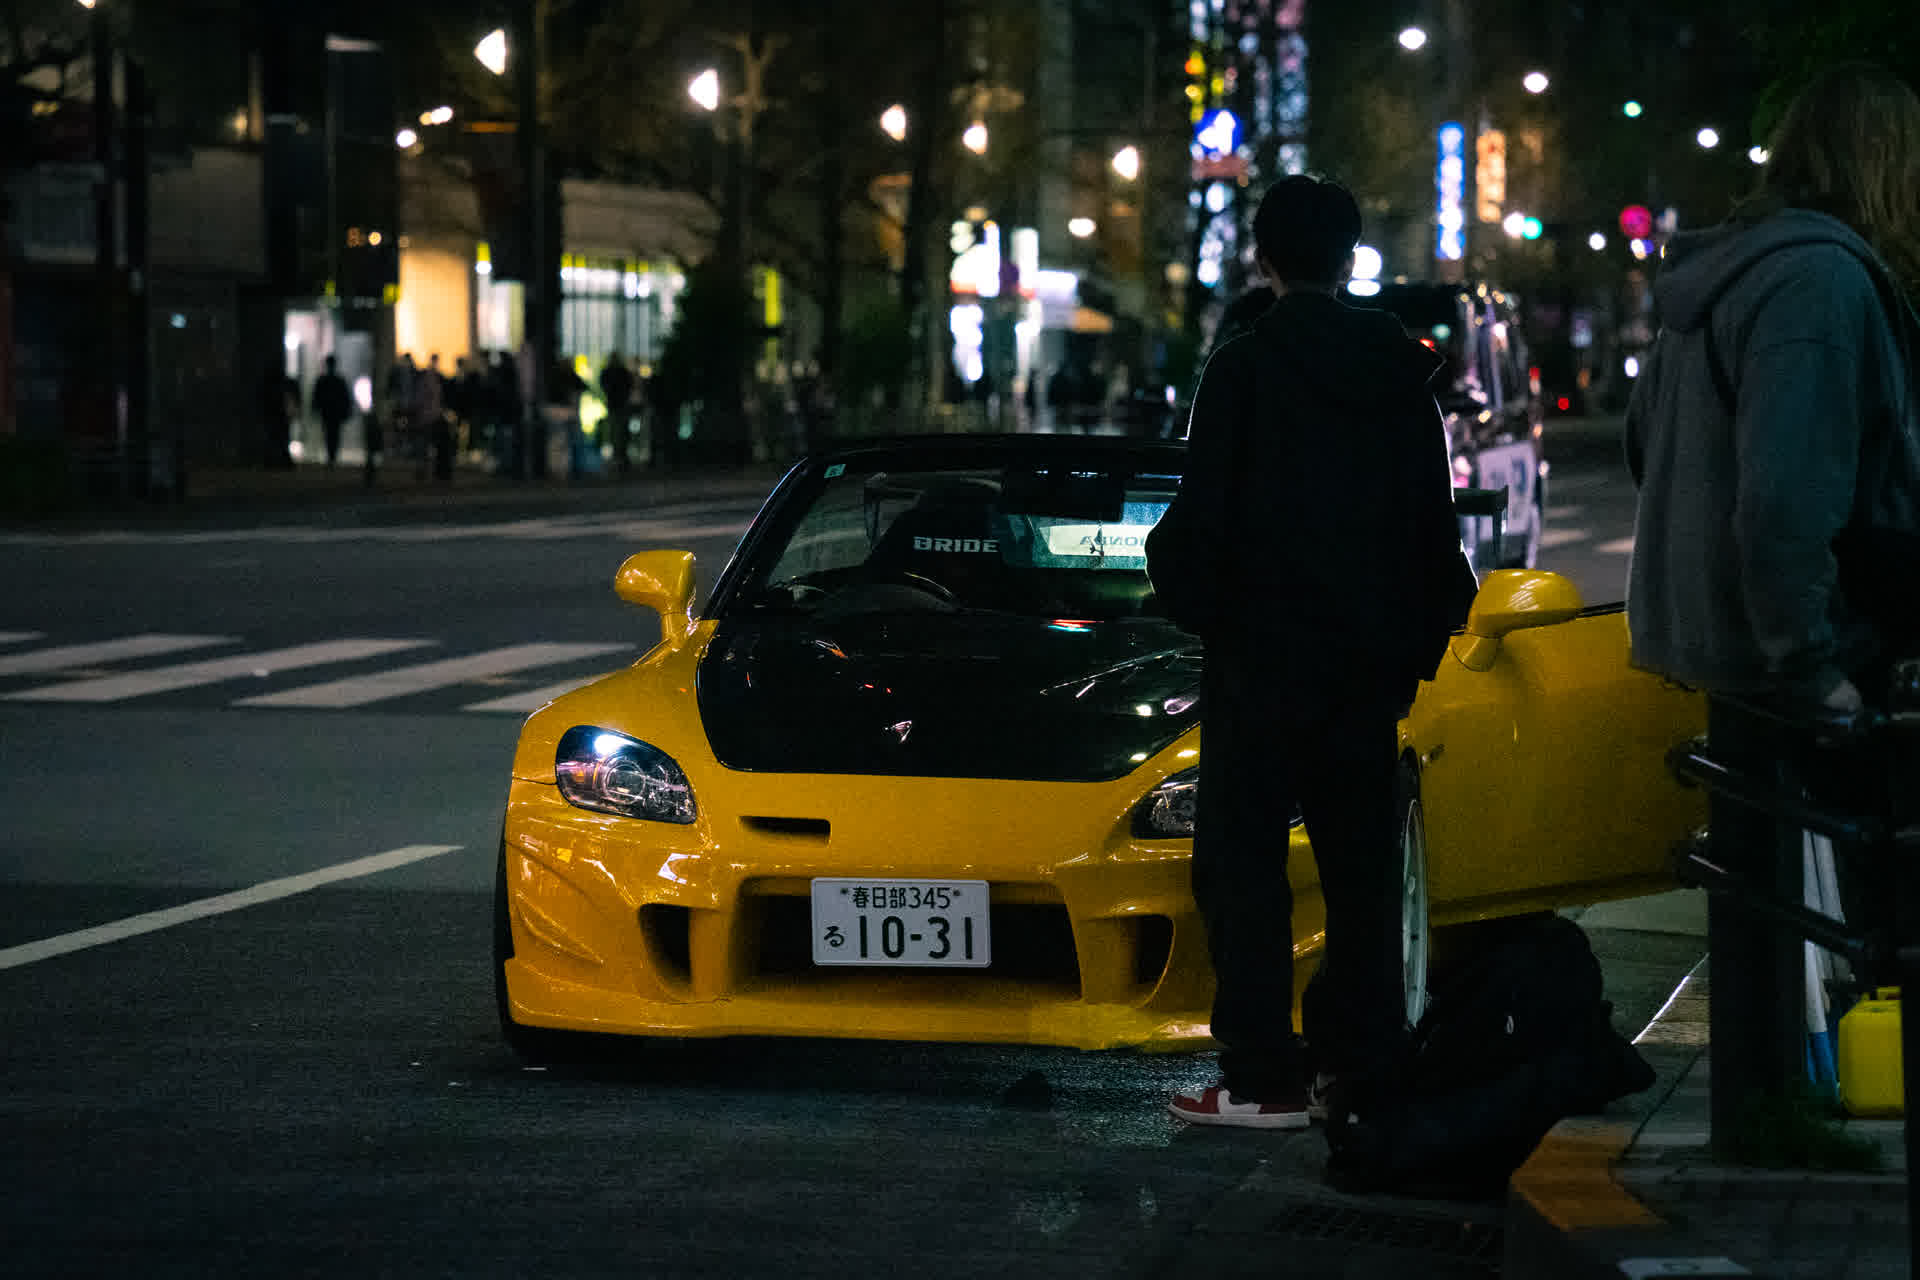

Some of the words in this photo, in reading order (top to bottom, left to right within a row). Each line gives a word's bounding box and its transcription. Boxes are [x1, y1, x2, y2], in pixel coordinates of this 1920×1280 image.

[913, 536, 999, 552] BRIDE
[852, 886, 951, 909] 春日部345
[823, 925, 845, 948] る
[858, 915, 973, 960] 10-31
